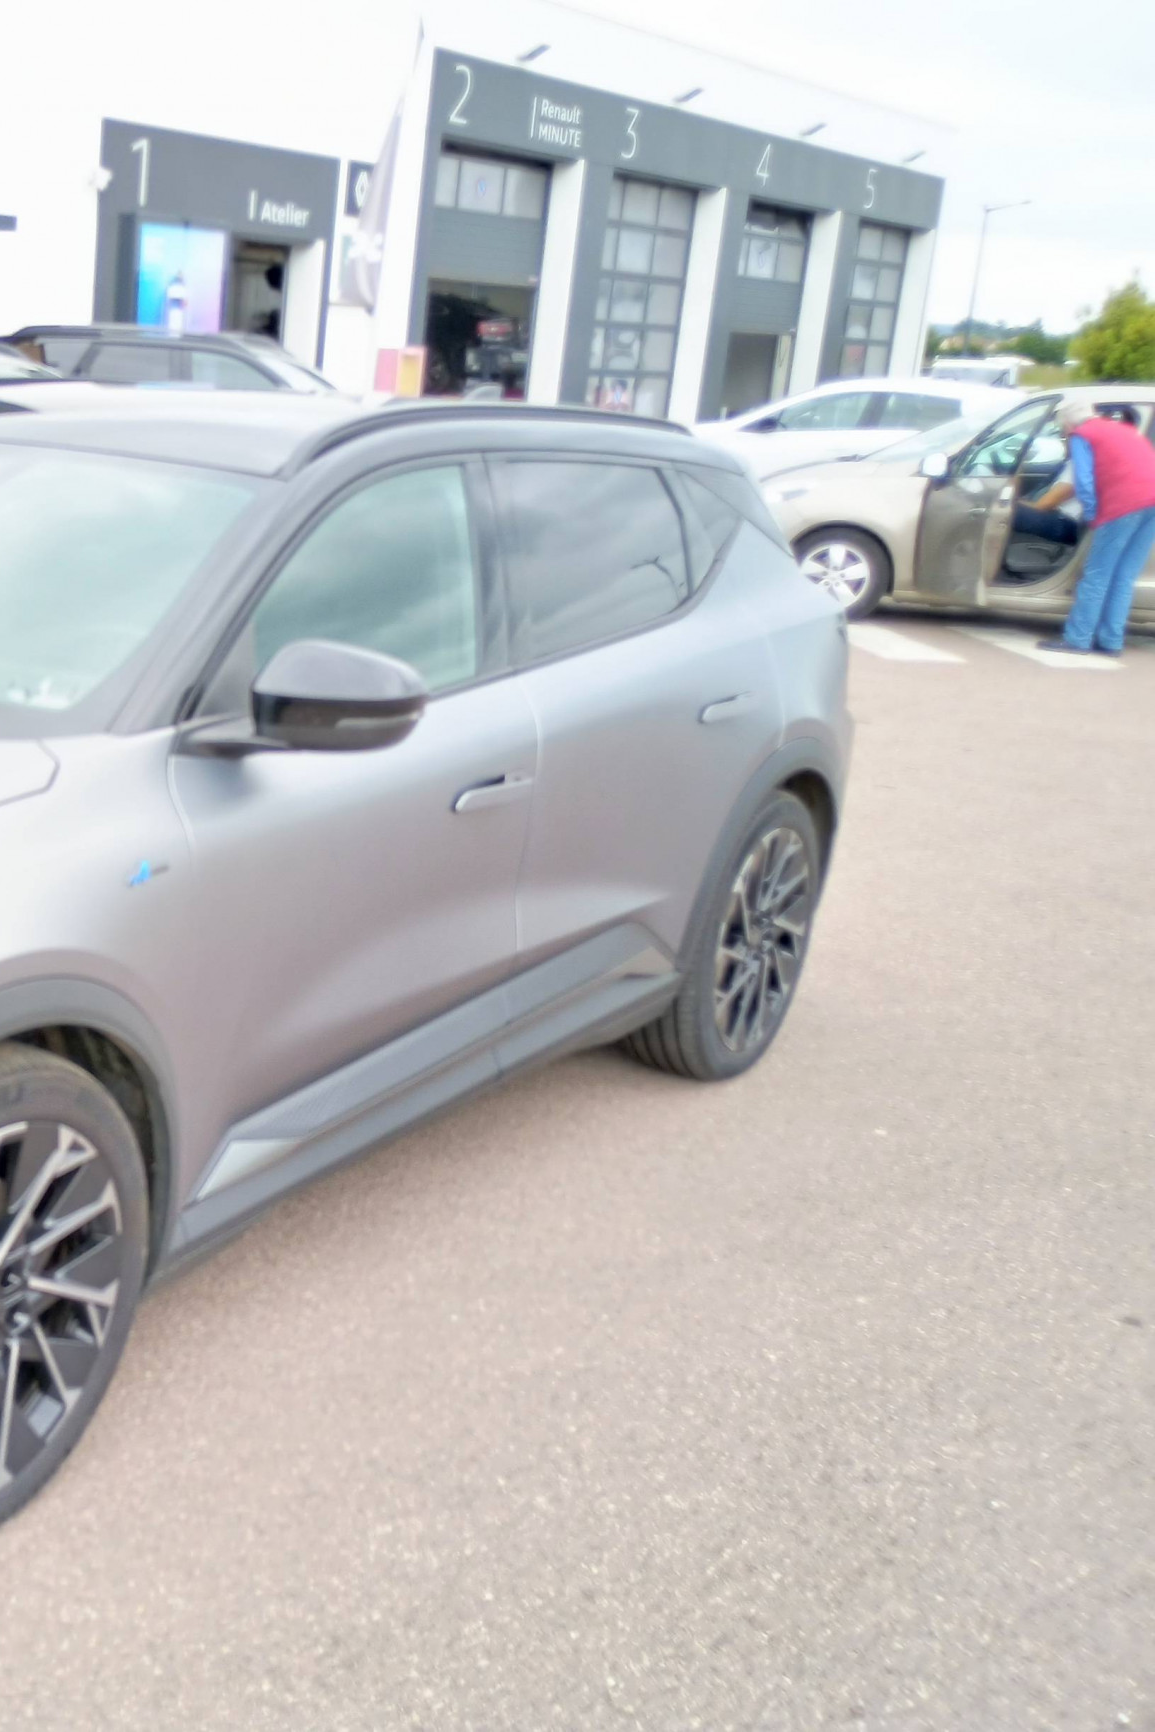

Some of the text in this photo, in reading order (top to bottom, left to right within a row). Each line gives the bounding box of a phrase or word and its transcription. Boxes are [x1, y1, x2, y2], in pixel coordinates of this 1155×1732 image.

[448, 65, 471, 124] 2
[540, 99, 581, 124] Renault
[538, 123, 582, 148] MINUTE
[620, 107, 639, 159] 3
[131, 138, 150, 207] 1
[756, 143, 771, 187] 4
[863, 168, 878, 209] 5
[261, 201, 310, 228] Atelier
